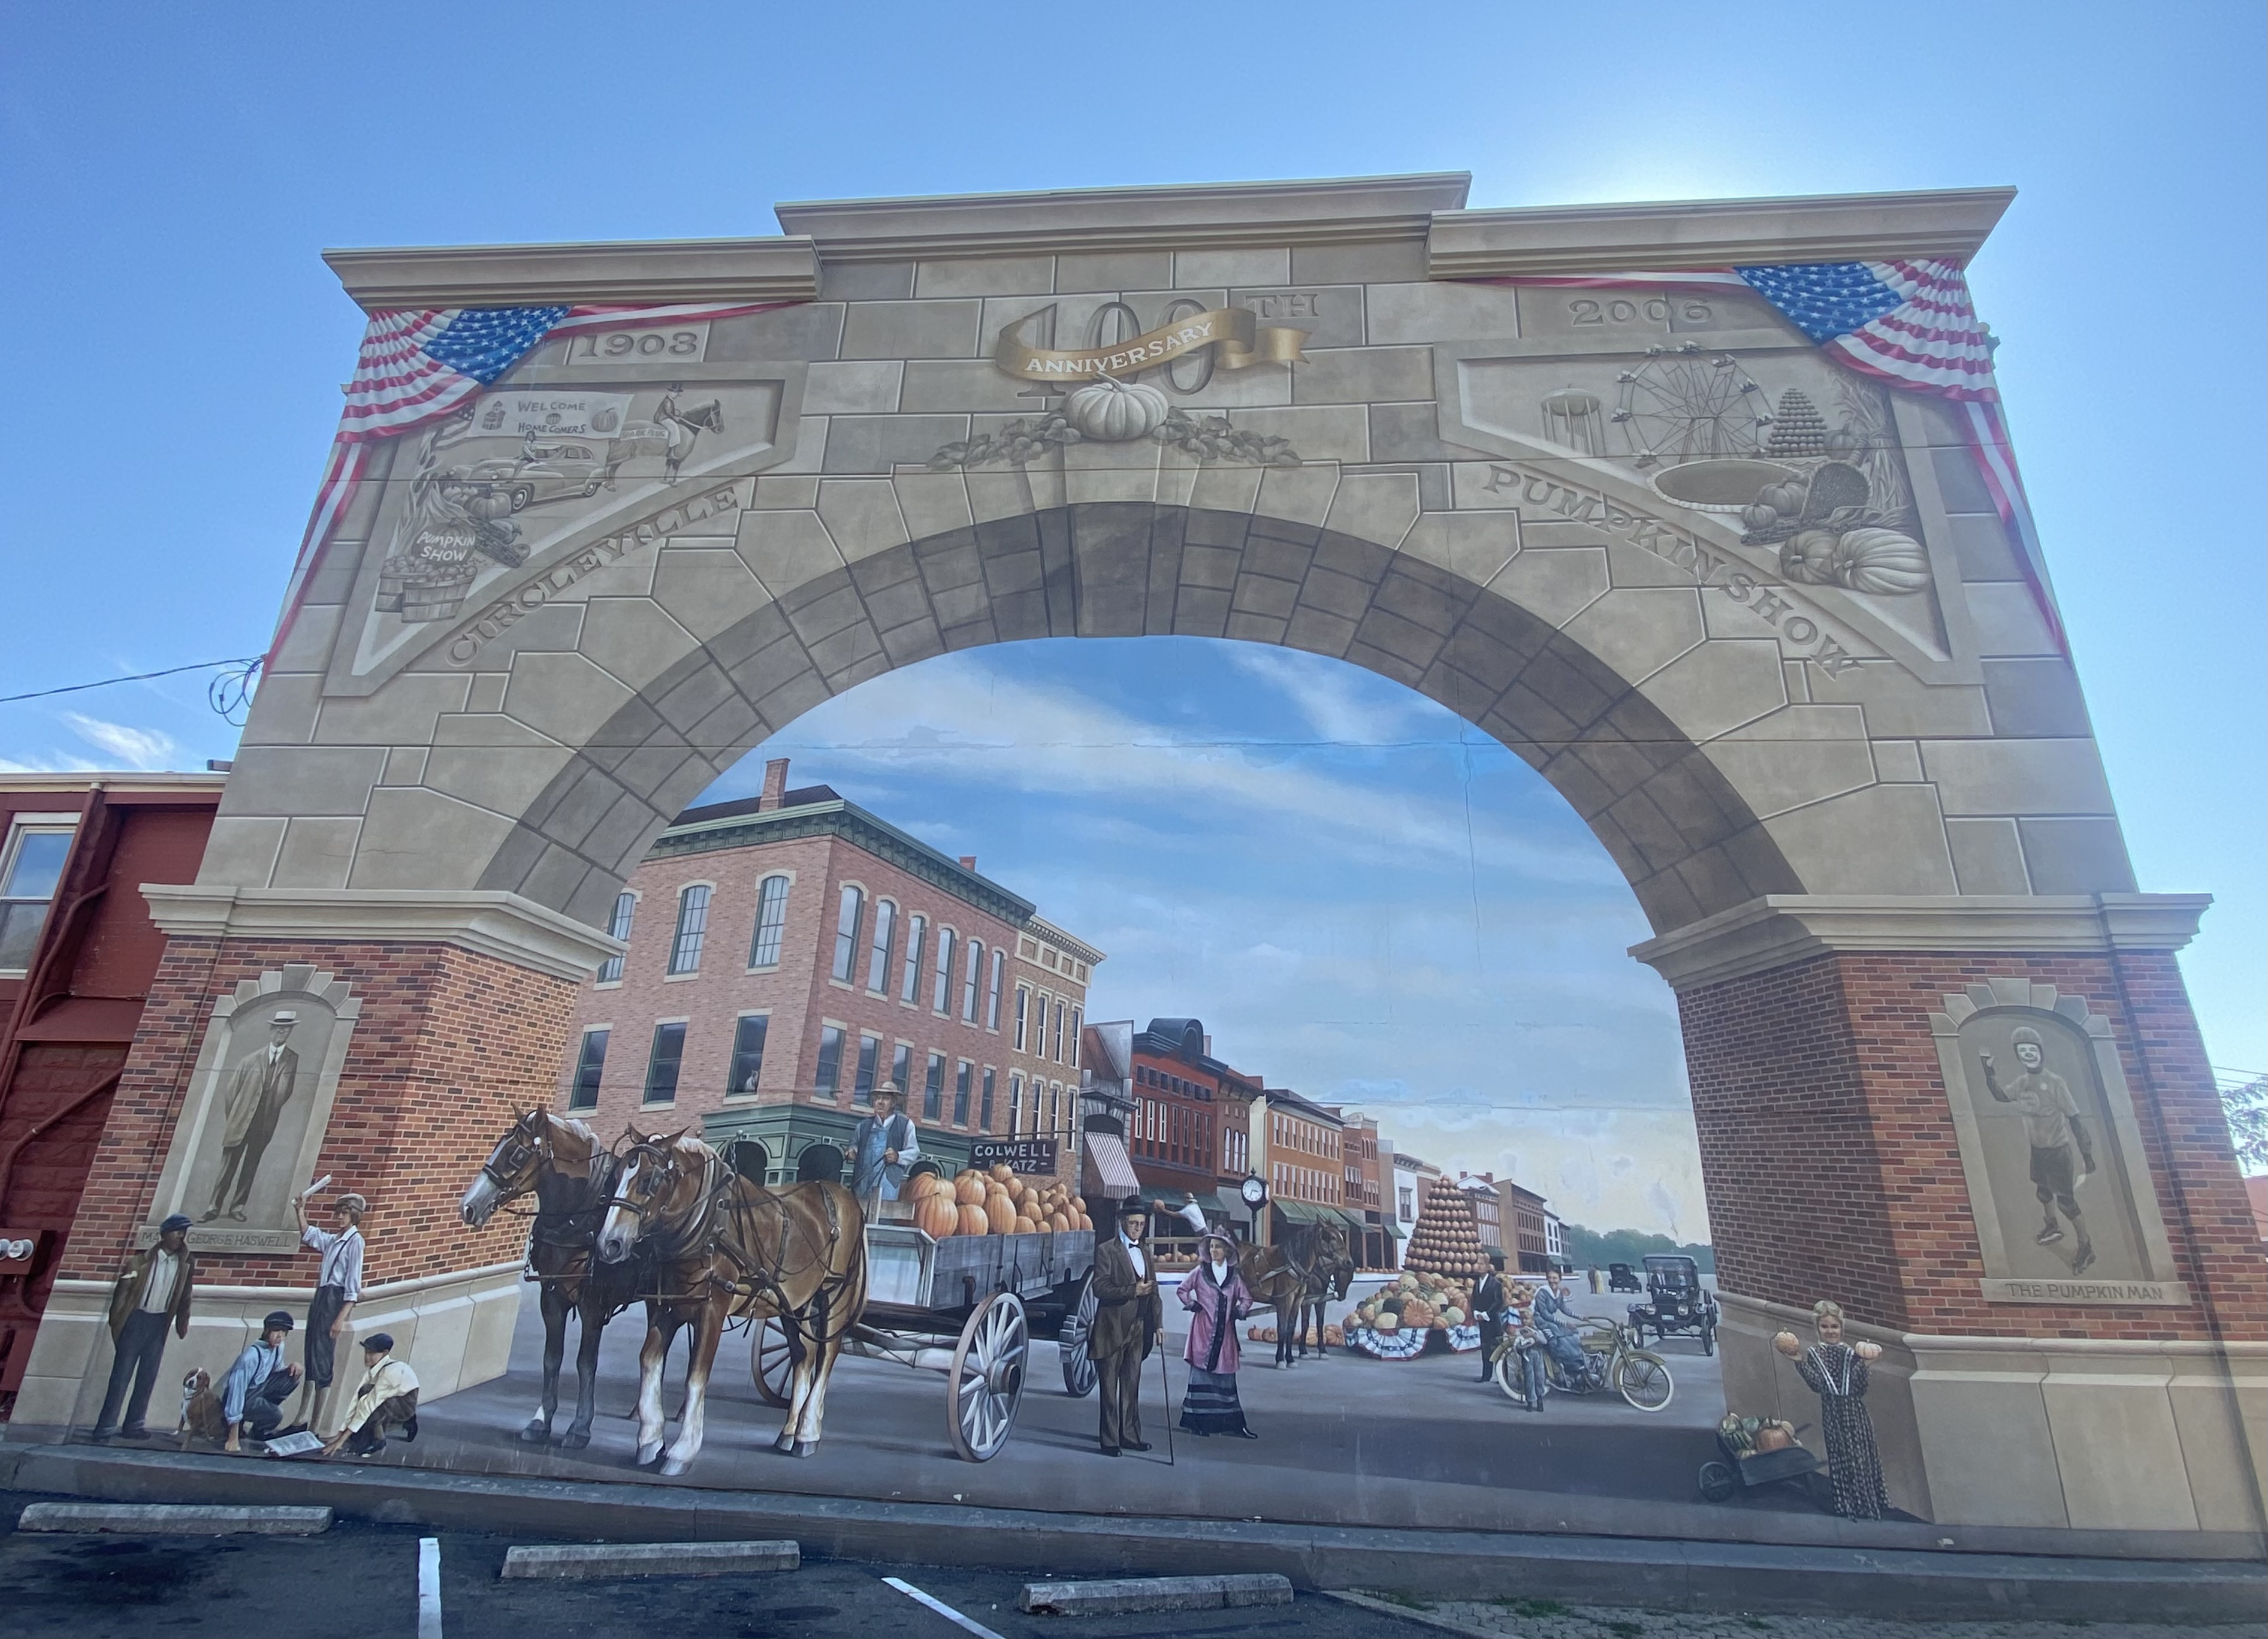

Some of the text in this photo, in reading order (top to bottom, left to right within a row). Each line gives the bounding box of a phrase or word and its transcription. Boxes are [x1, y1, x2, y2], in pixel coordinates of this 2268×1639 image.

[1569, 298, 1713, 327] 2006
[579, 332, 699, 358] 1903
[1025, 321, 1213, 373] ANNIVERSARY
[518, 400, 587, 412] WELCOME
[416, 530, 476, 548] PUMPKIN
[420, 545, 467, 562] SHOW
[446, 487, 739, 665] CIRCLEVILLE
[1482, 464, 1865, 682] PUMPKIN SHOW
[974, 1143, 1050, 1157] COLWELL
[186, 1232, 232, 1245] GEORGE
[234, 1234, 291, 1248] HASWELL
[2005, 1283, 2164, 1300] THE PUMPKIN MAN
